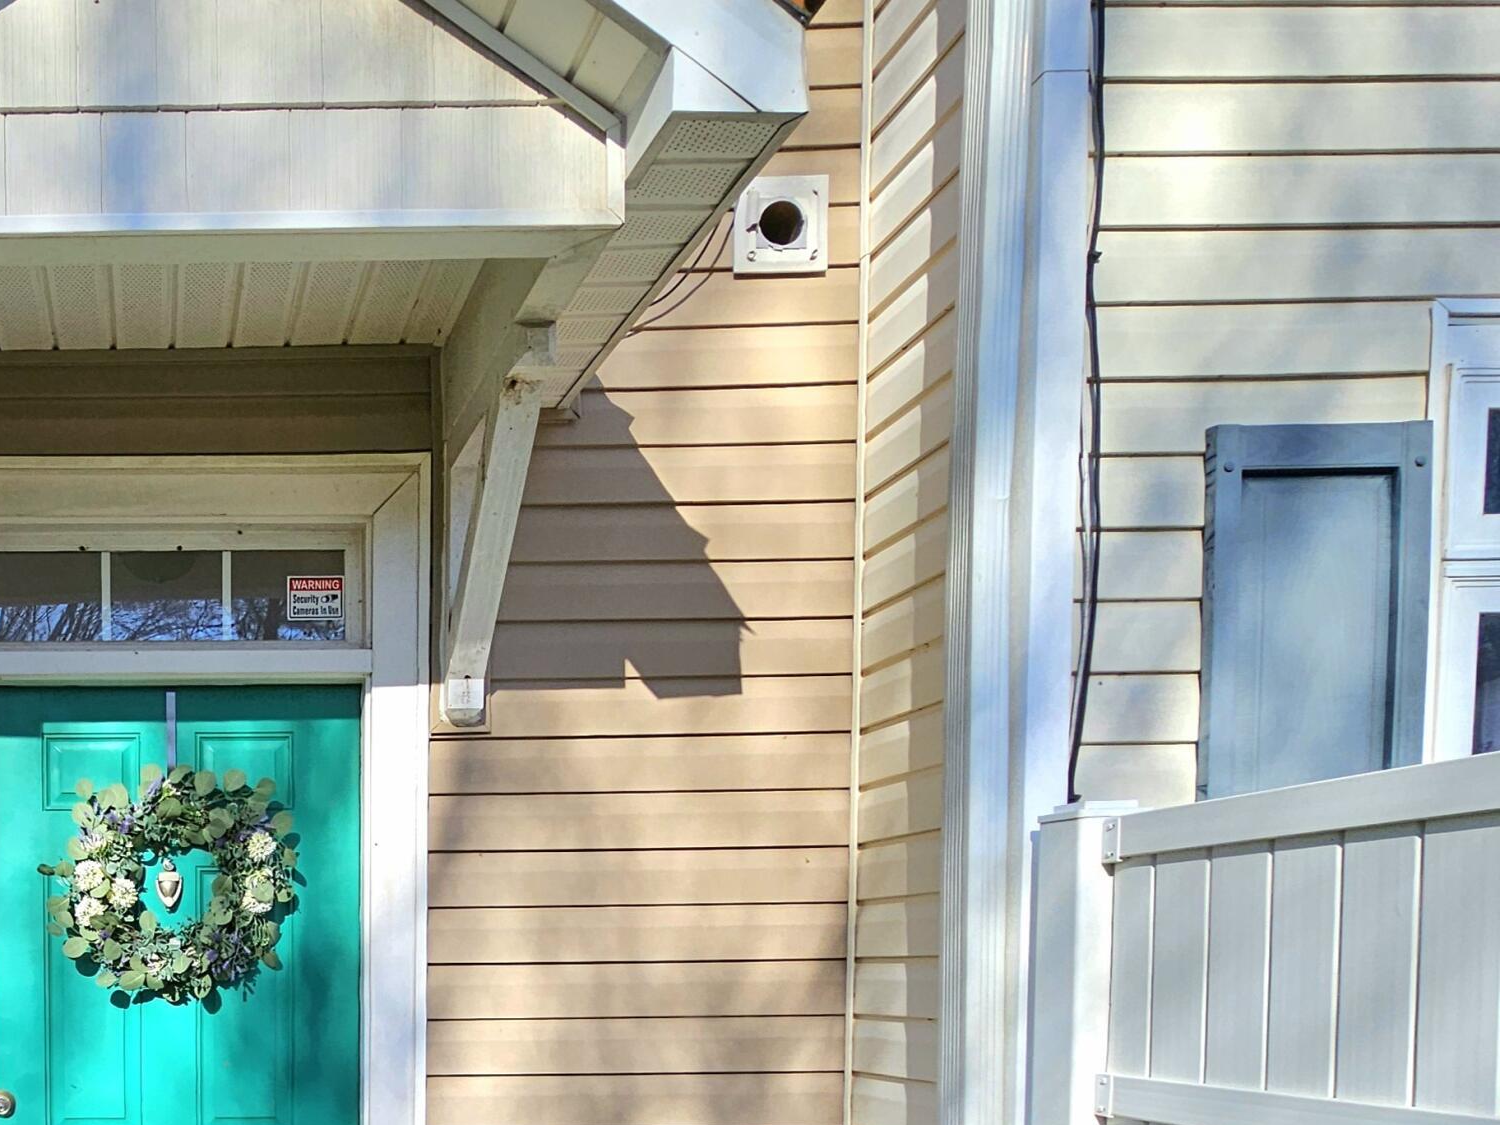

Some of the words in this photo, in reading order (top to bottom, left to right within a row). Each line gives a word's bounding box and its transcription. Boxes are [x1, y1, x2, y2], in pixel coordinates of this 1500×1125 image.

[292, 580, 340, 590] WARNING
[293, 594, 319, 605] Security
[293, 606, 319, 615] Cameras
[320, 606, 327, 615] In
[328, 606, 339, 615] Use
